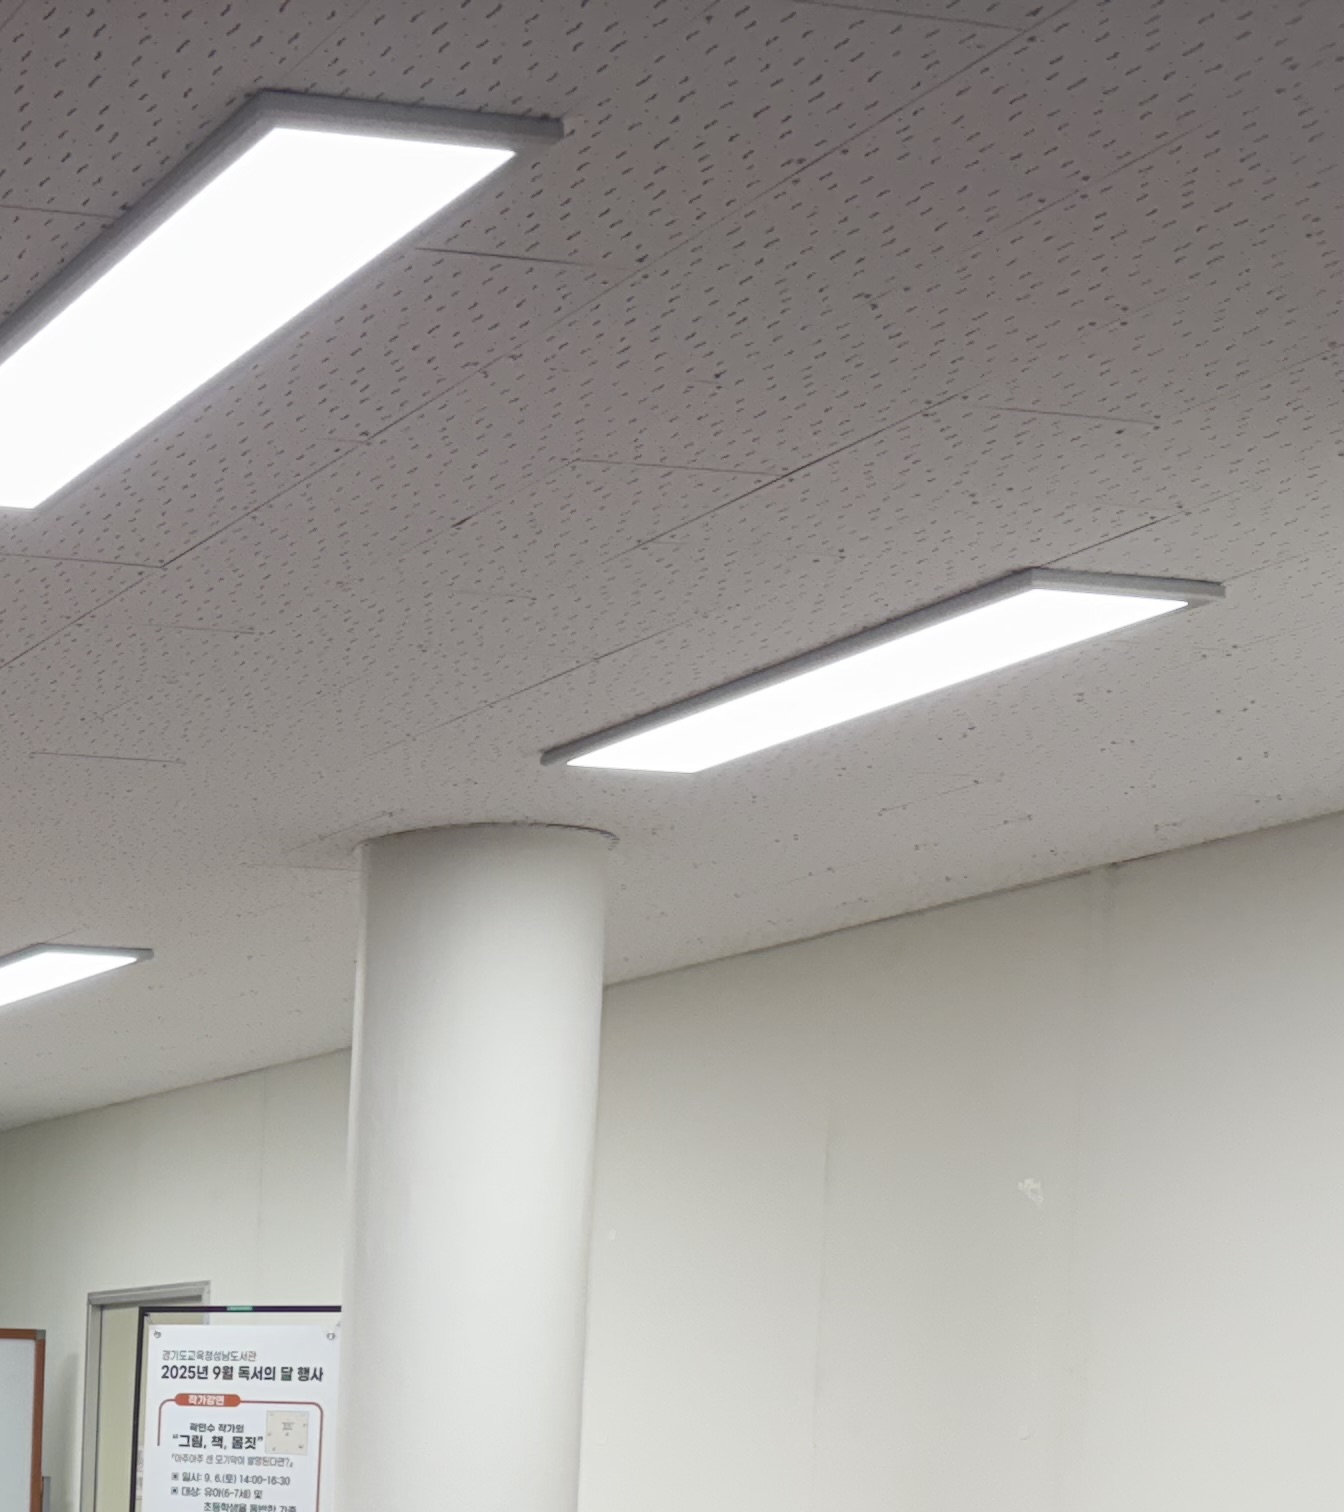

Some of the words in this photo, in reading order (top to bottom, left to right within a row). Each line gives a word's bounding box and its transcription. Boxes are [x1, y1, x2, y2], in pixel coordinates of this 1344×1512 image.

[161, 1350, 257, 1362] 경기도교육청성남도서관
[161, 1365, 209, 1380] 2025년
[212, 1365, 234, 1381] 9월
[238, 1366, 276, 1381] 독서의
[280, 1366, 294, 1382] 달
[297, 1366, 324, 1382] 행사
[188, 1394, 225, 1406] 작가강연
[218, 1423, 244, 1434] 작가의
[211, 1435, 227, 1450] 책,
